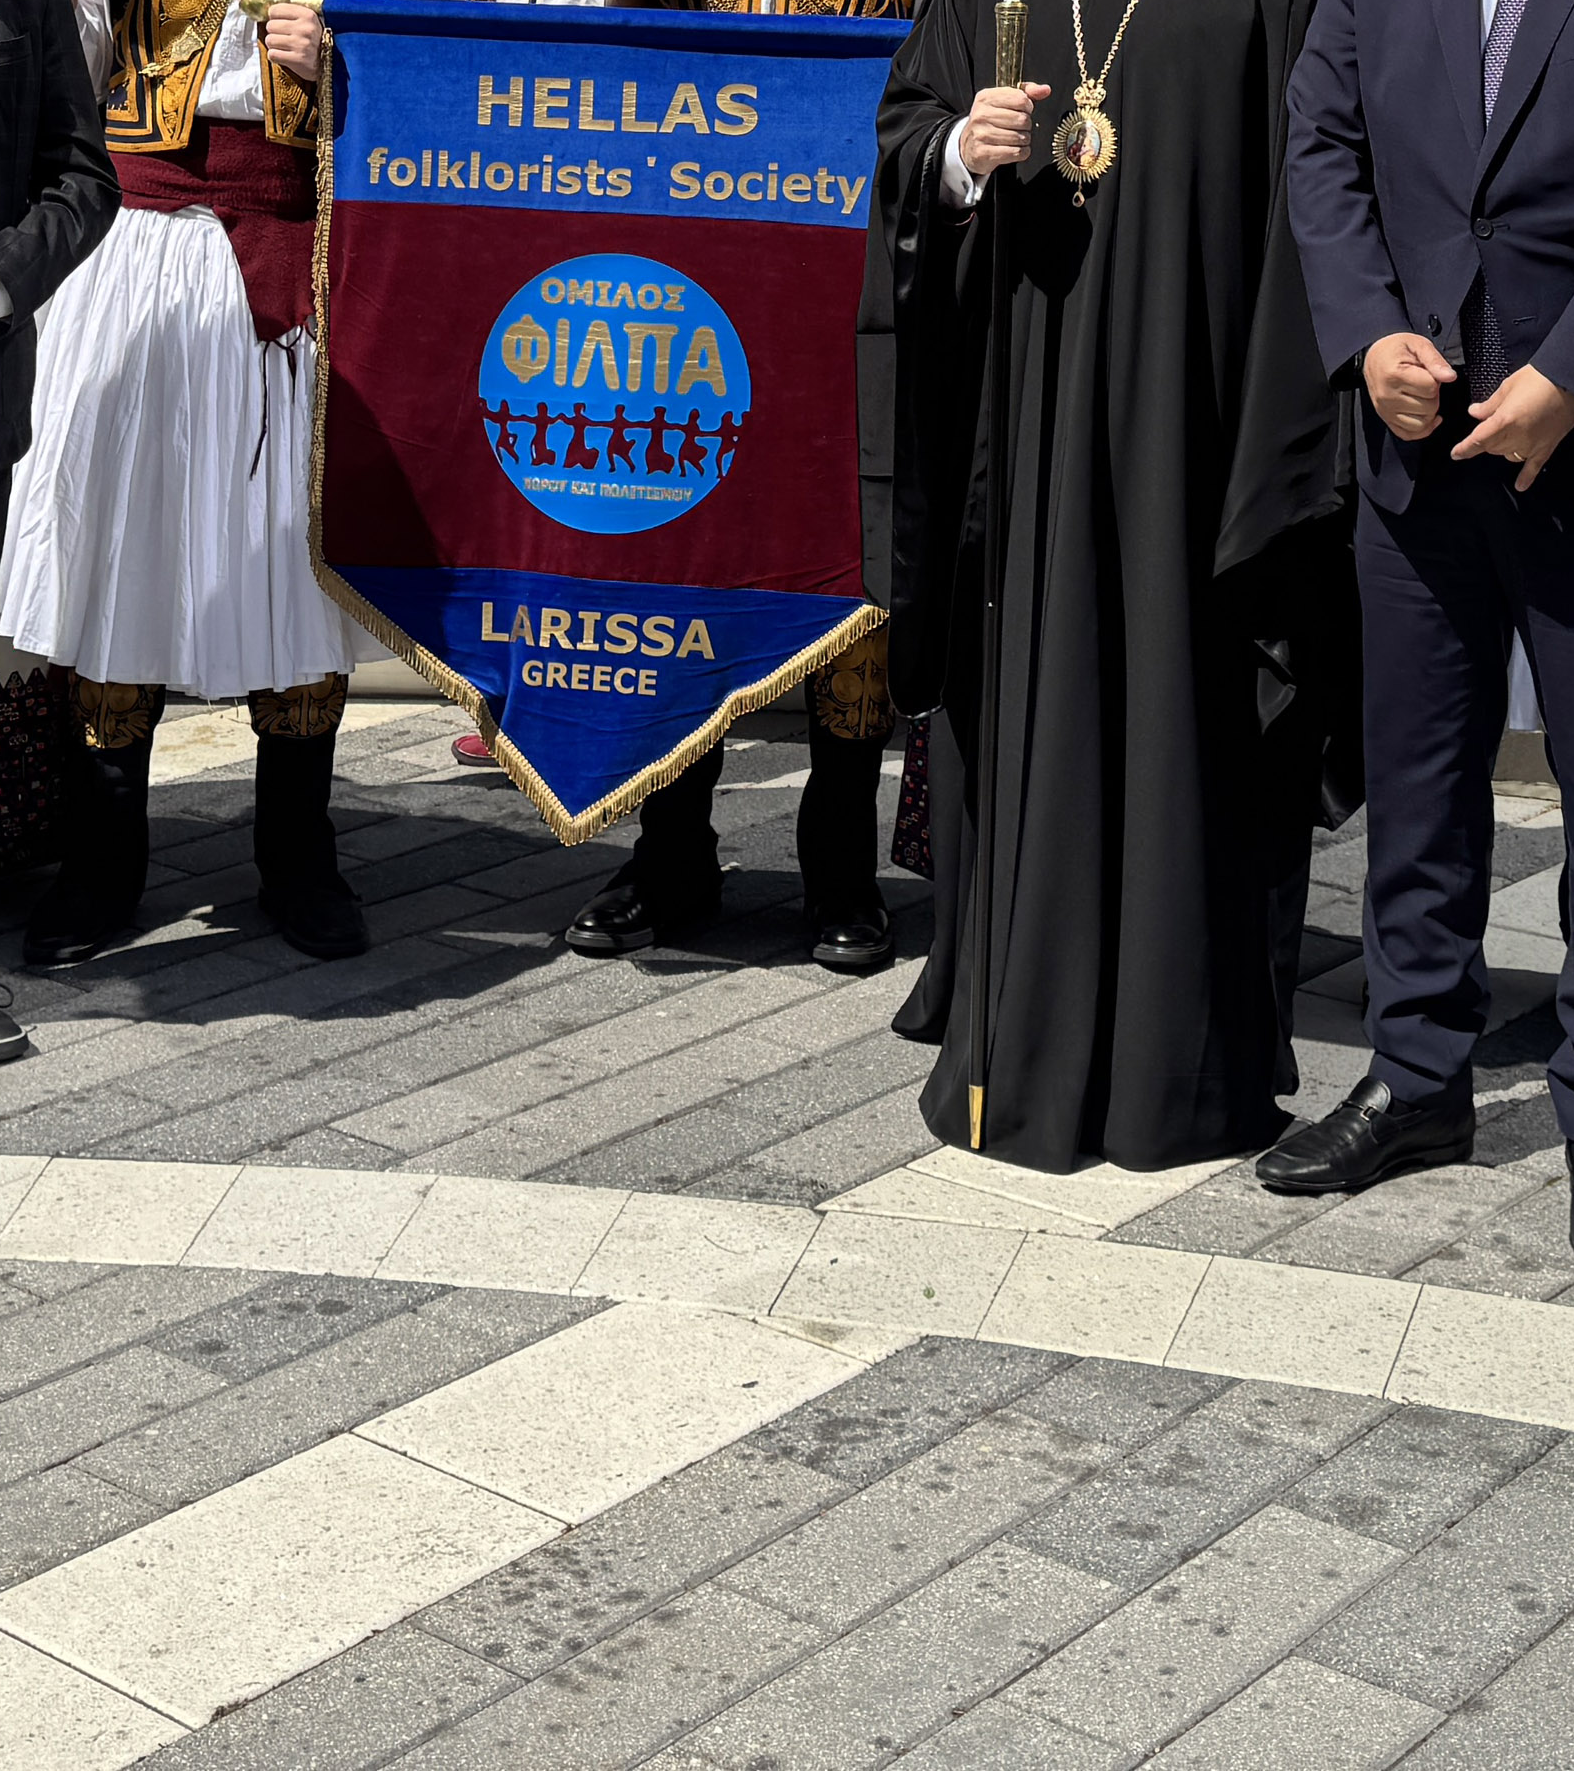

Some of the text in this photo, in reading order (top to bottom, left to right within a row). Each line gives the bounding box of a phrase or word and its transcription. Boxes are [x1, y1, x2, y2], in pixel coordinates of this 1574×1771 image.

[477, 74, 759, 136] HELLAS
[669, 161, 867, 215] Society
[540, 277, 686, 312] ΟΜΙΛΟΣ
[501, 314, 727, 397] ΦΙΛΠΑ
[481, 601, 716, 660] LARISSA
[522, 660, 658, 697] GREECE
